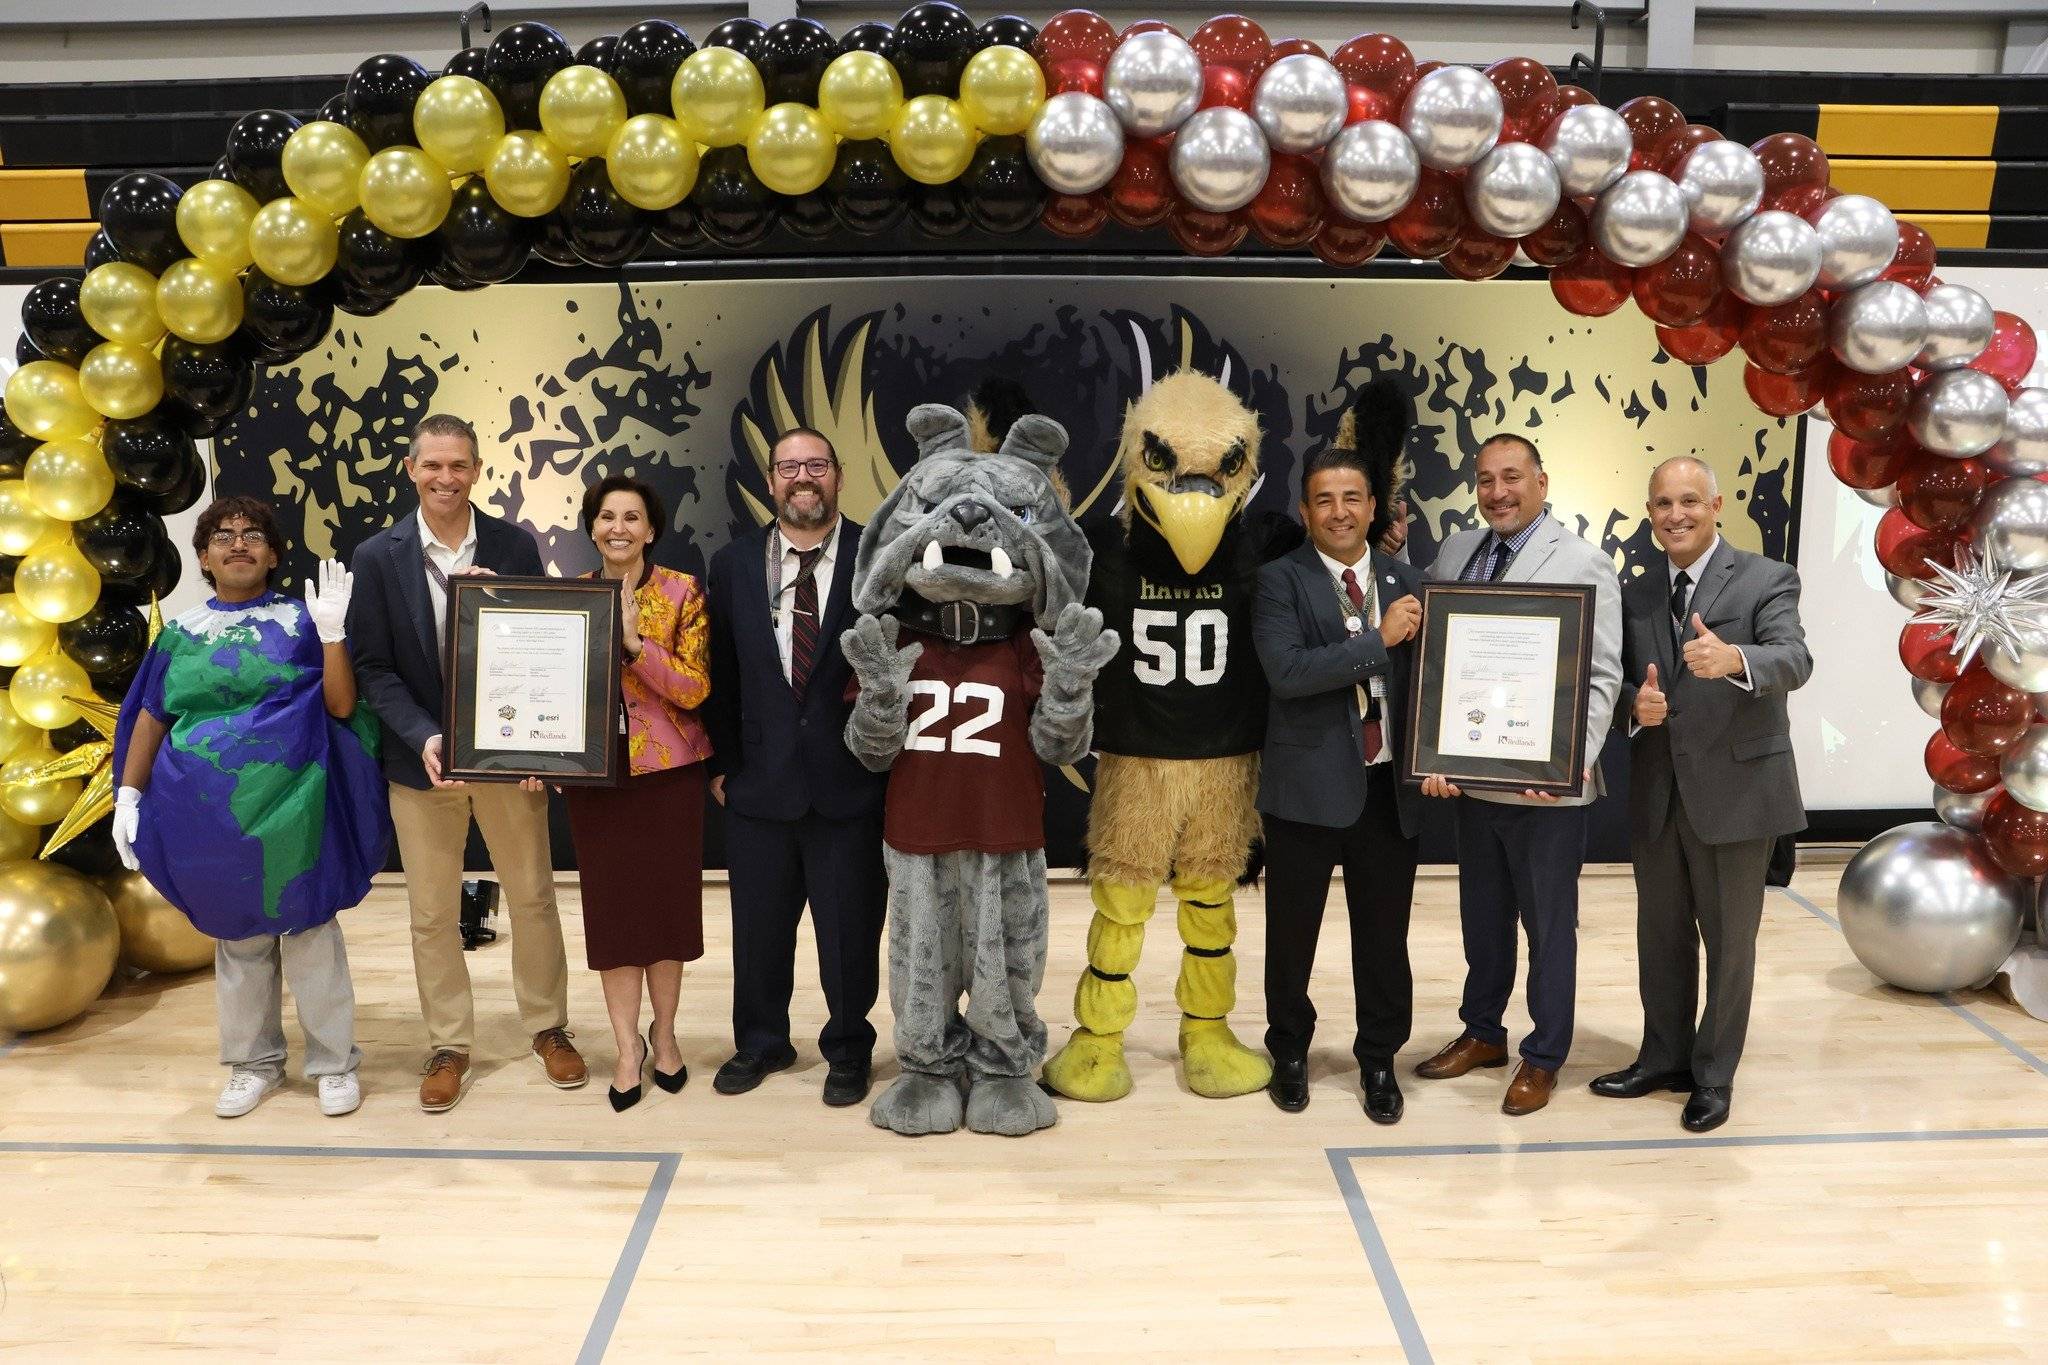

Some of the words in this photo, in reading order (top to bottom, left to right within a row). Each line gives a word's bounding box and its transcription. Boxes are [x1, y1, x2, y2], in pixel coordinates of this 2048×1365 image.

[1132, 608, 1229, 686] 50
[545, 713, 560, 722] esri
[904, 679, 1005, 758] 22
[1515, 719, 1530, 727] esri
